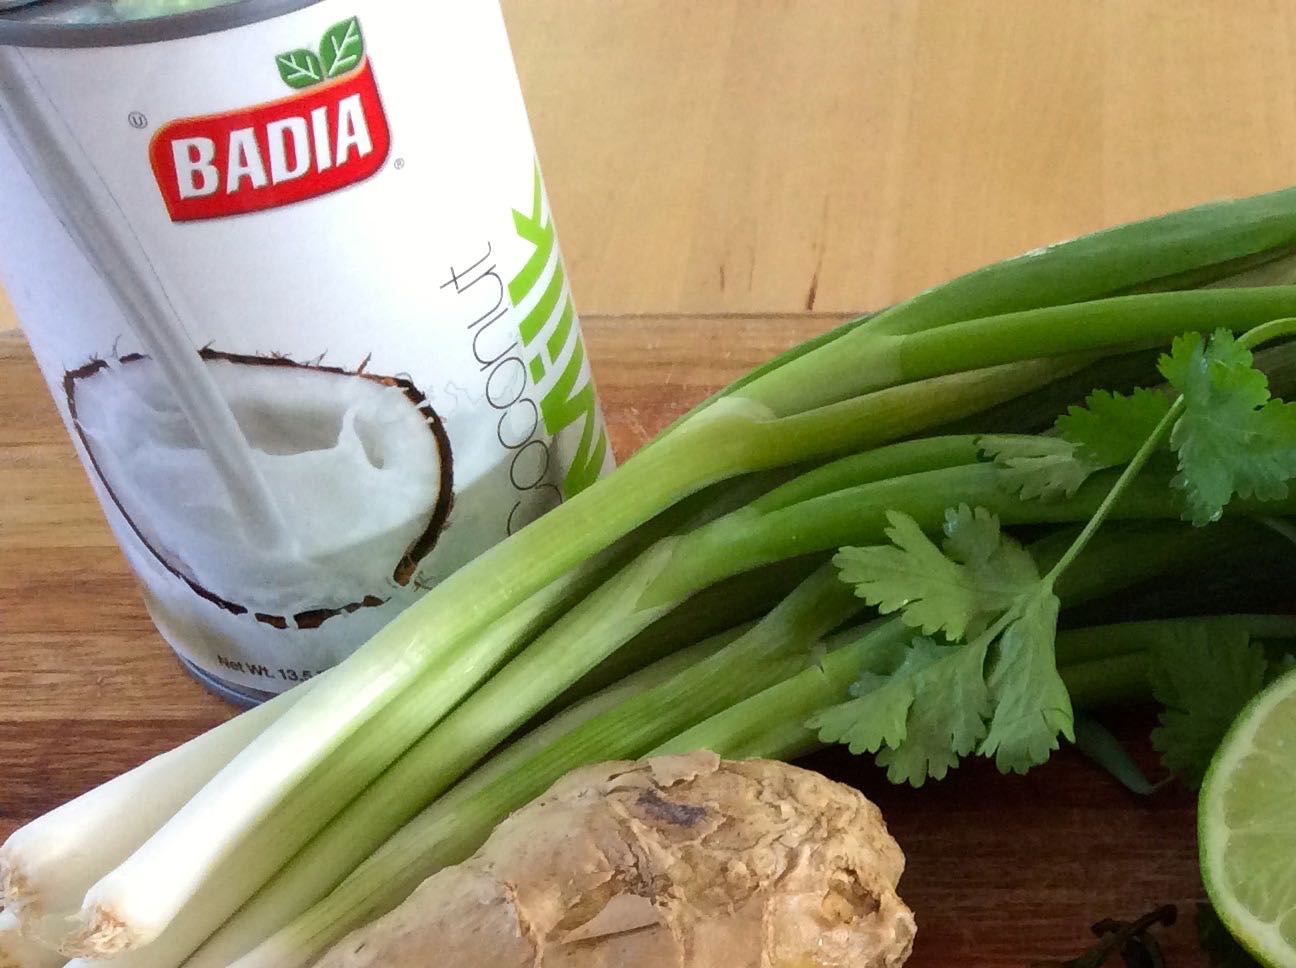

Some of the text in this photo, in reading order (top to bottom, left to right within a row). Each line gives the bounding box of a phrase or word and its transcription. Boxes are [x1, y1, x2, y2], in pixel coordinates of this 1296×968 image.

[171, 94, 372, 200] BADIA
[440, 242, 562, 534] coconut
[216, 654, 245, 673] Net
[245, 661, 275, 679] Wt.
